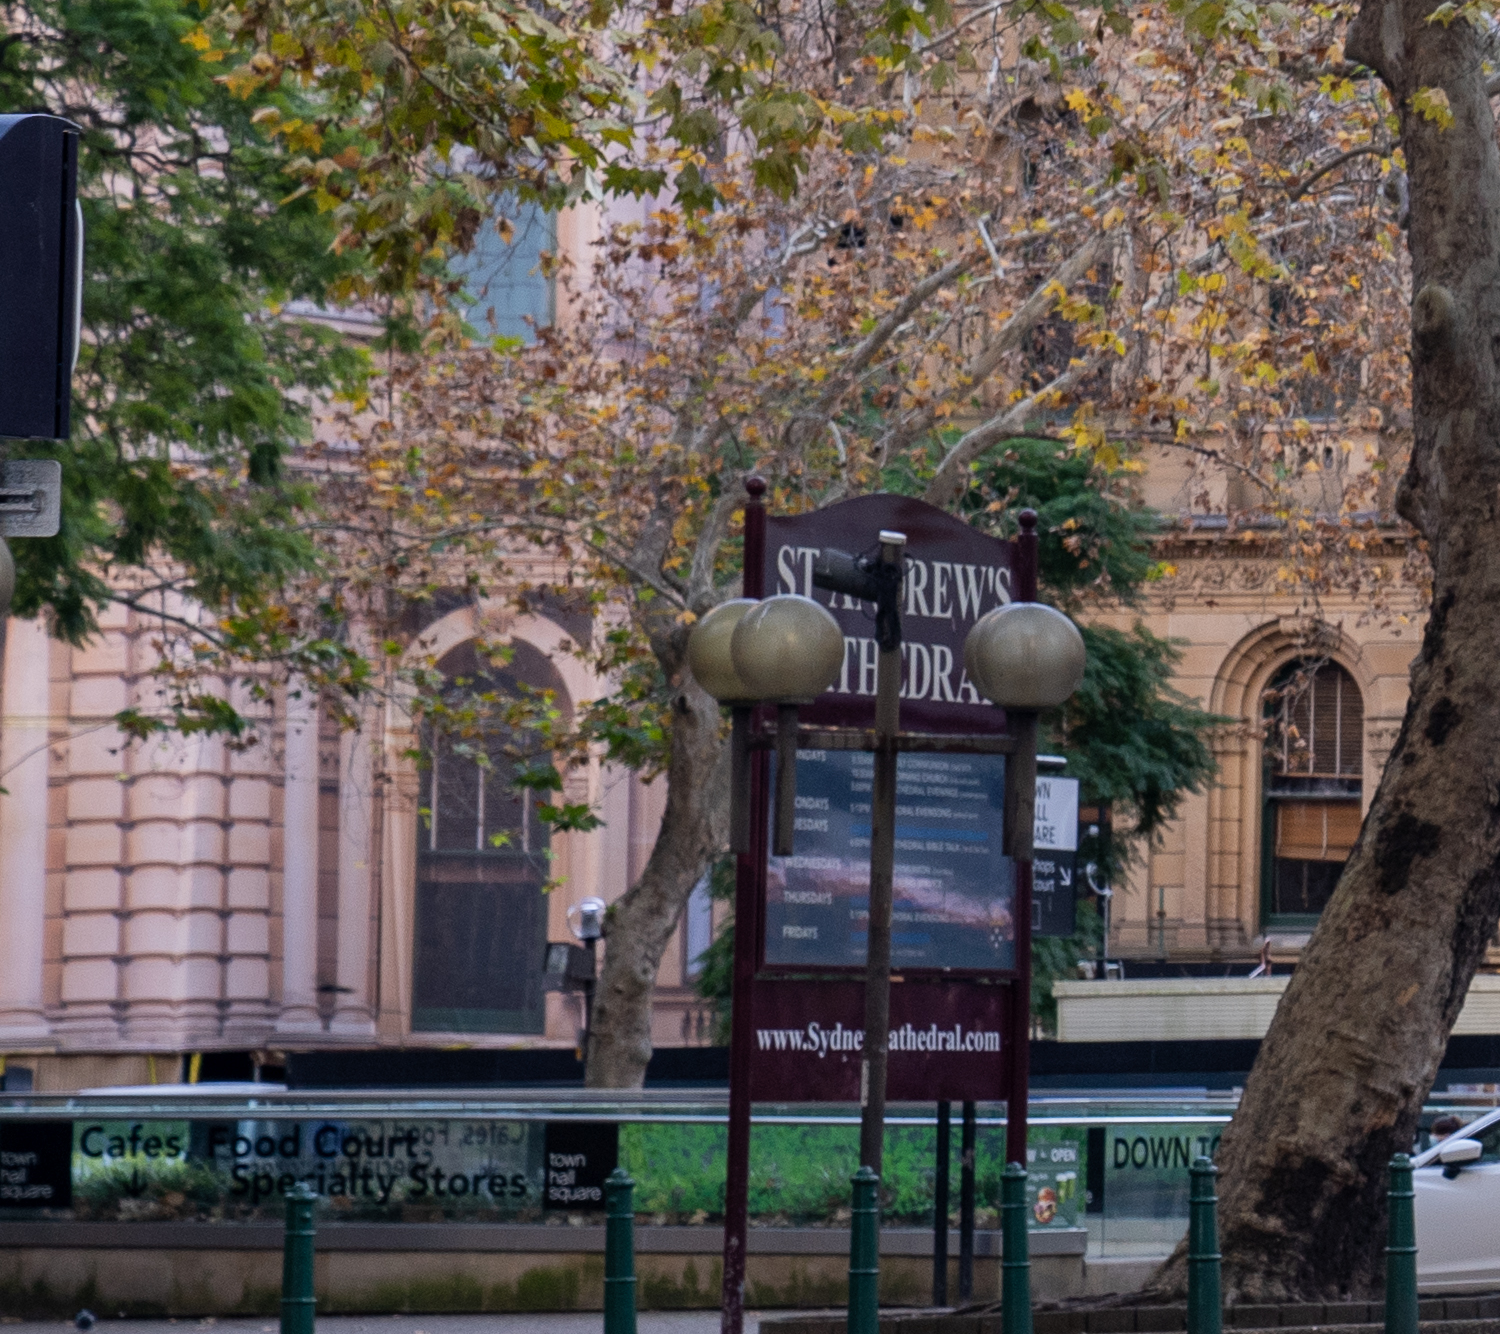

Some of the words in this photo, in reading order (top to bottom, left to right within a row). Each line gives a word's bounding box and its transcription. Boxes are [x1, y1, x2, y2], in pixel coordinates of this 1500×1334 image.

[777, 544, 821, 598] ST
[784, 891, 832, 905] THURSDAYS
[783, 925, 818, 940] FRIDAYS
[208, 1123, 299, 1158] Food
[313, 1125, 419, 1158] Court
[550, 1152, 586, 1167] town
[1051, 1148, 1076, 1162] OPEN
[1114, 1136, 1191, 1169] DOWN
[409, 1163, 527, 1198] Stores
[550, 1170, 576, 1185] hall
[550, 1185, 602, 1203] square
